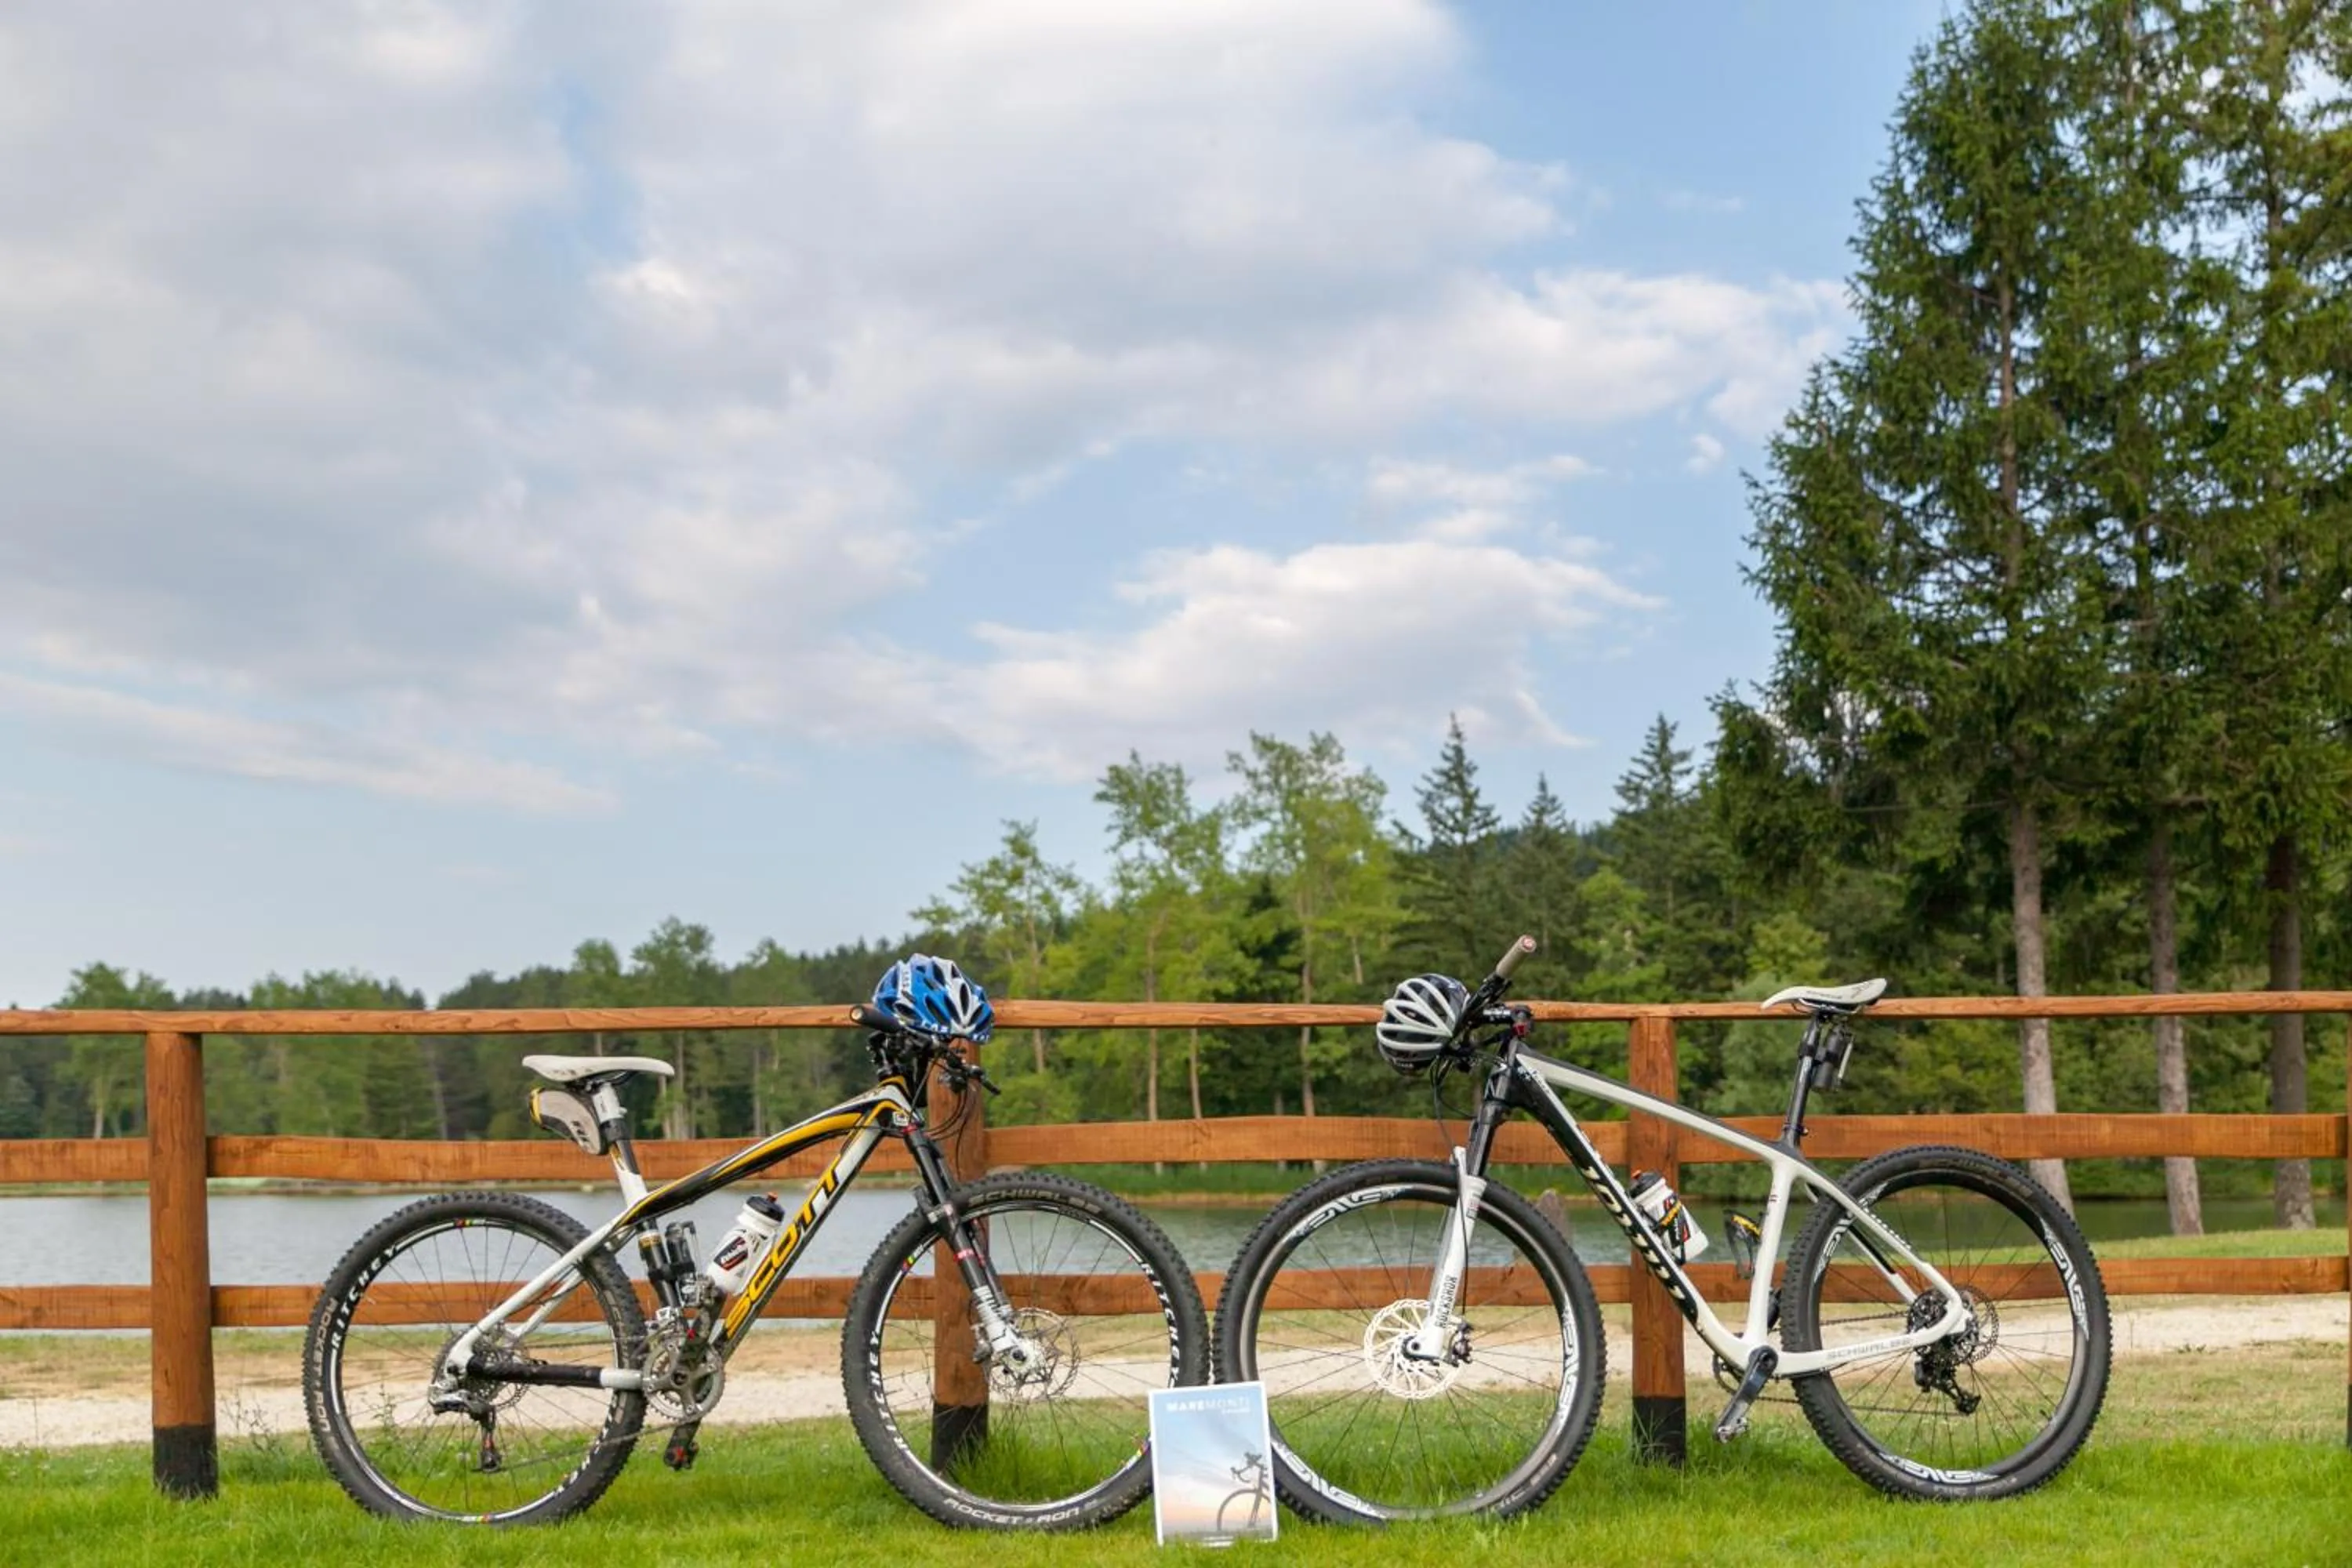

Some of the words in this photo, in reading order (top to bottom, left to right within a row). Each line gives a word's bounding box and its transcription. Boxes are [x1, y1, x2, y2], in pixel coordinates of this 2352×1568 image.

[726, 1154, 841, 1340] SCOTT
[968, 1189, 1102, 1214] SCHWALBE
[331, 1245, 396, 1350] RITCHEY
[1140, 1263, 1180, 1381] RITCHEY
[869, 1335, 909, 1450] RITCHEY
[943, 1497, 1021, 1524] ROCKET
